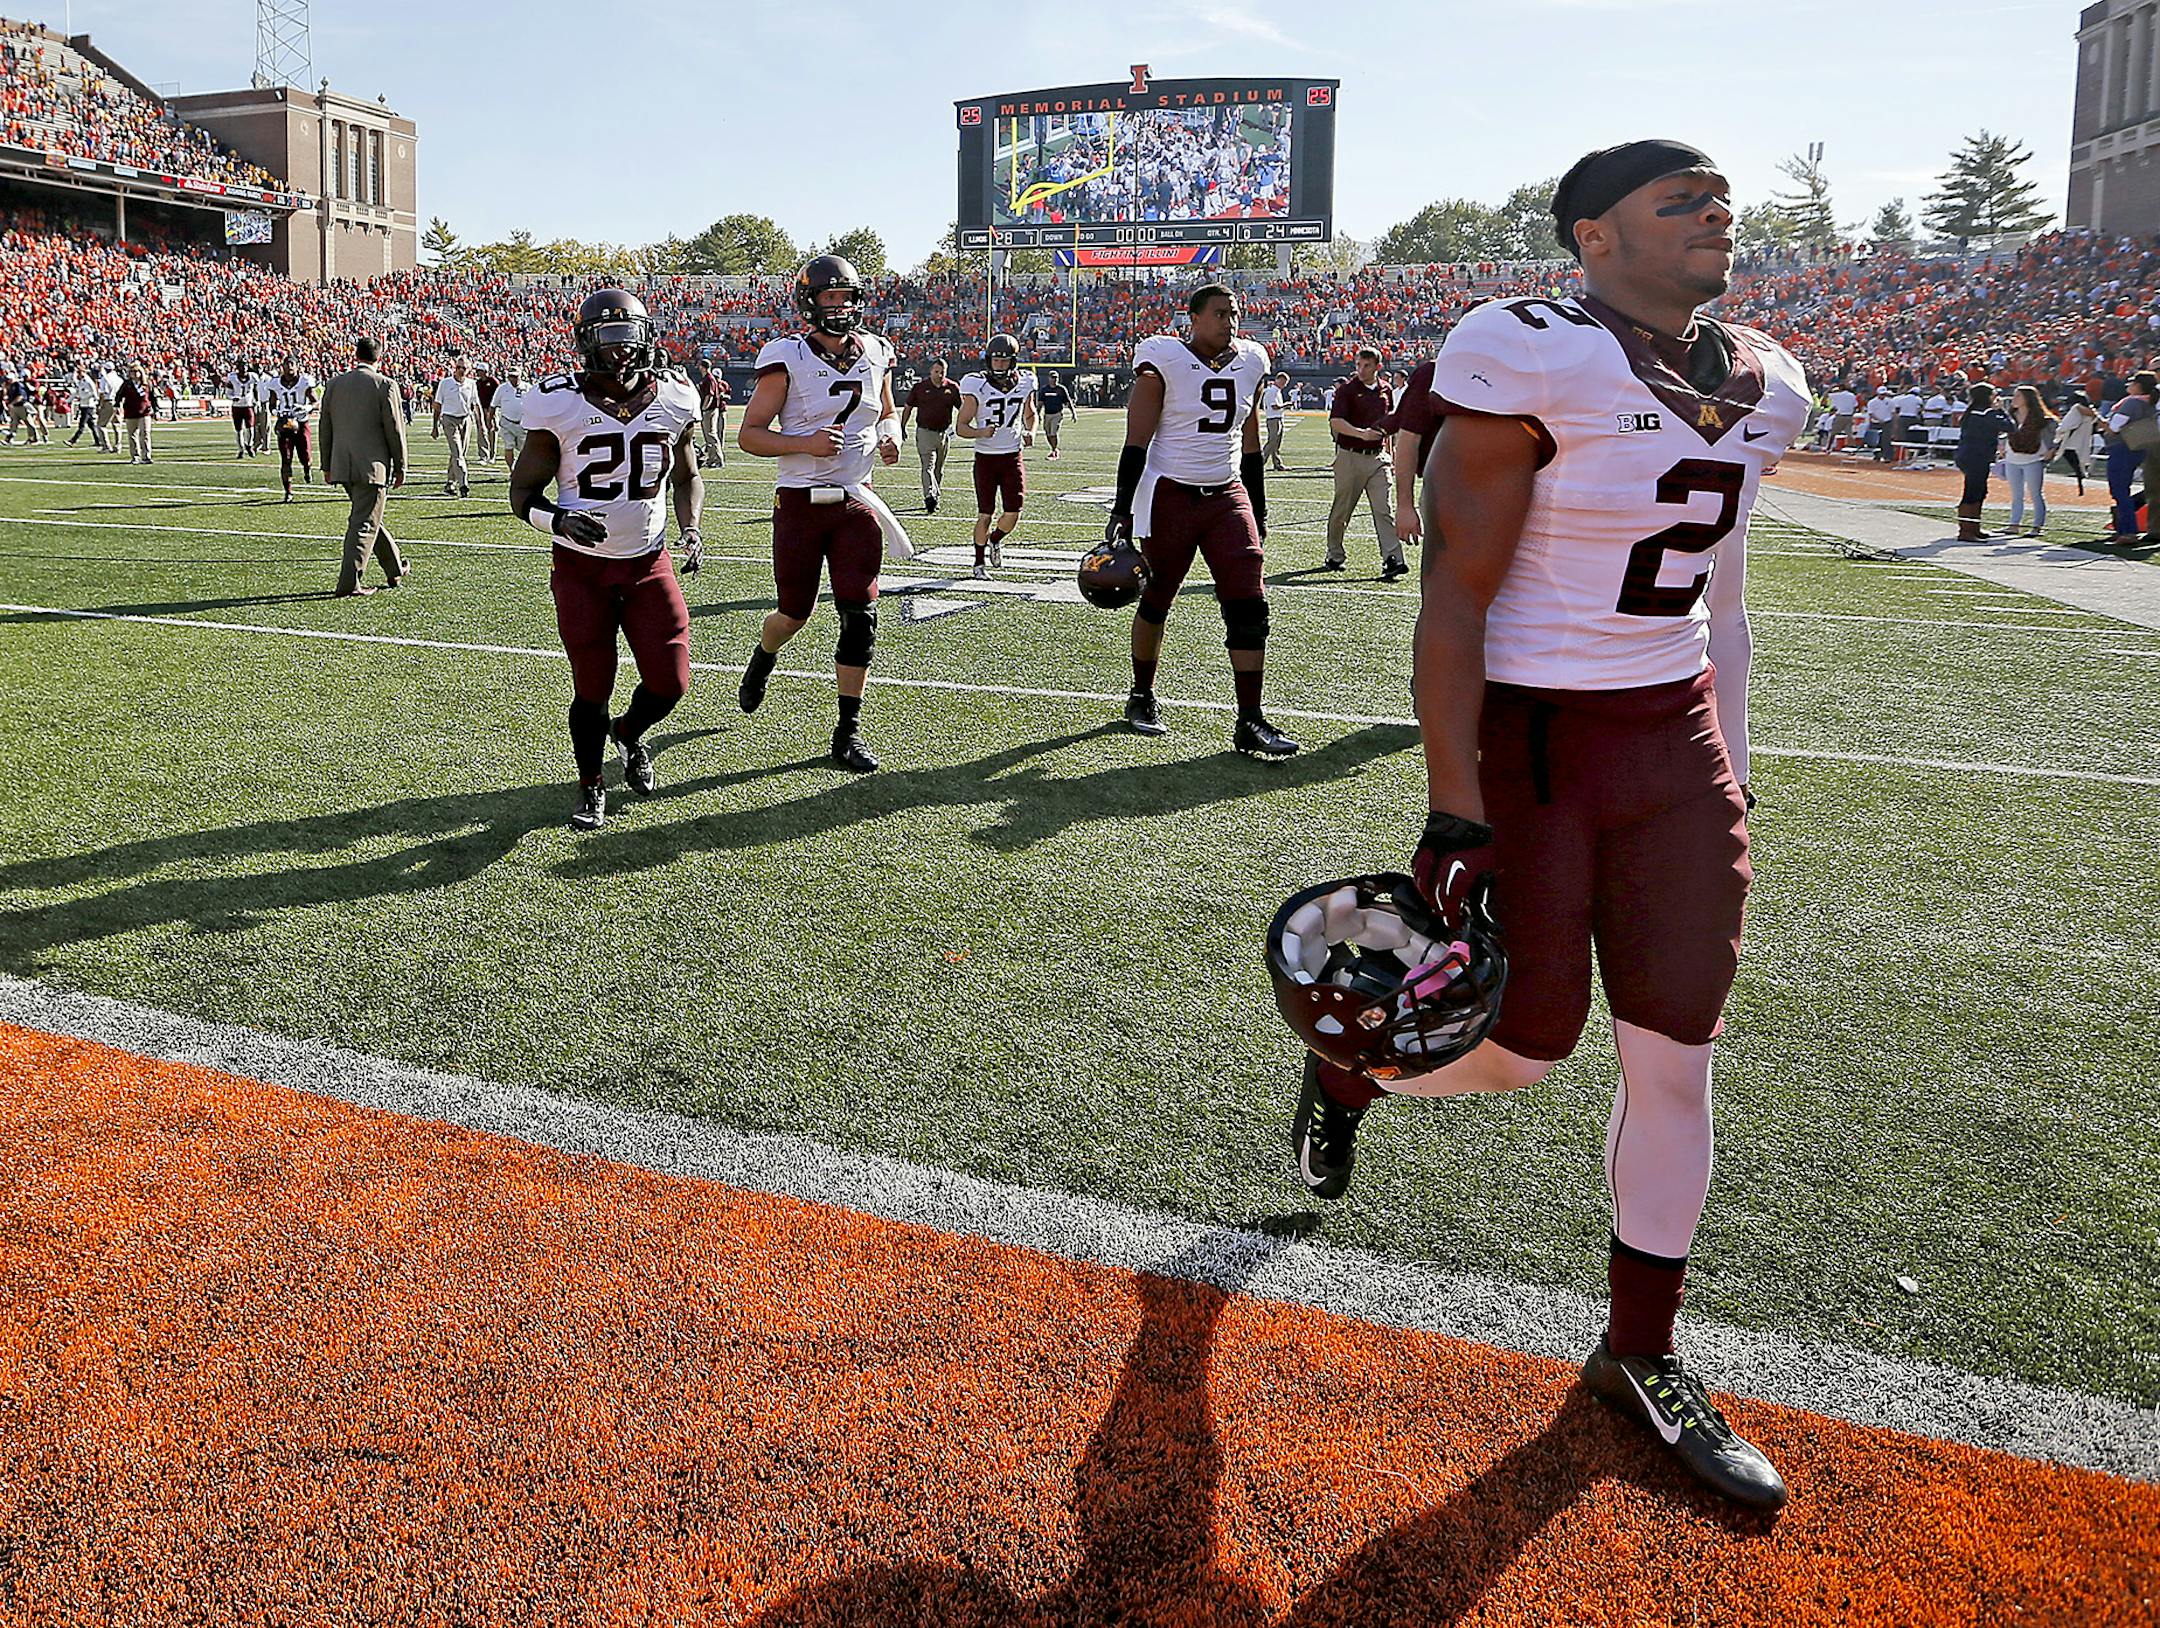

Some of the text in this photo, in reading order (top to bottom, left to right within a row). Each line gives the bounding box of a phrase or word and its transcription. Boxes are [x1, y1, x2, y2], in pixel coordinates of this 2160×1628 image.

[1130, 64, 1149, 94] I
[1001, 88, 1283, 115] MEMORIAL STADIUM
[1309, 87, 1329, 105] 25
[962, 109, 981, 124] 25
[995, 231, 1013, 246] 28
[1222, 229, 1230, 237] 4
[1266, 224, 1286, 239] 24
[1092, 247, 1180, 260] FIGHTING ILLINI
[828, 380, 863, 425] 7
[985, 397, 1024, 428] 37
[1197, 378, 1237, 433] 9
[576, 431, 670, 500] 20
[1616, 458, 1746, 617] 2
